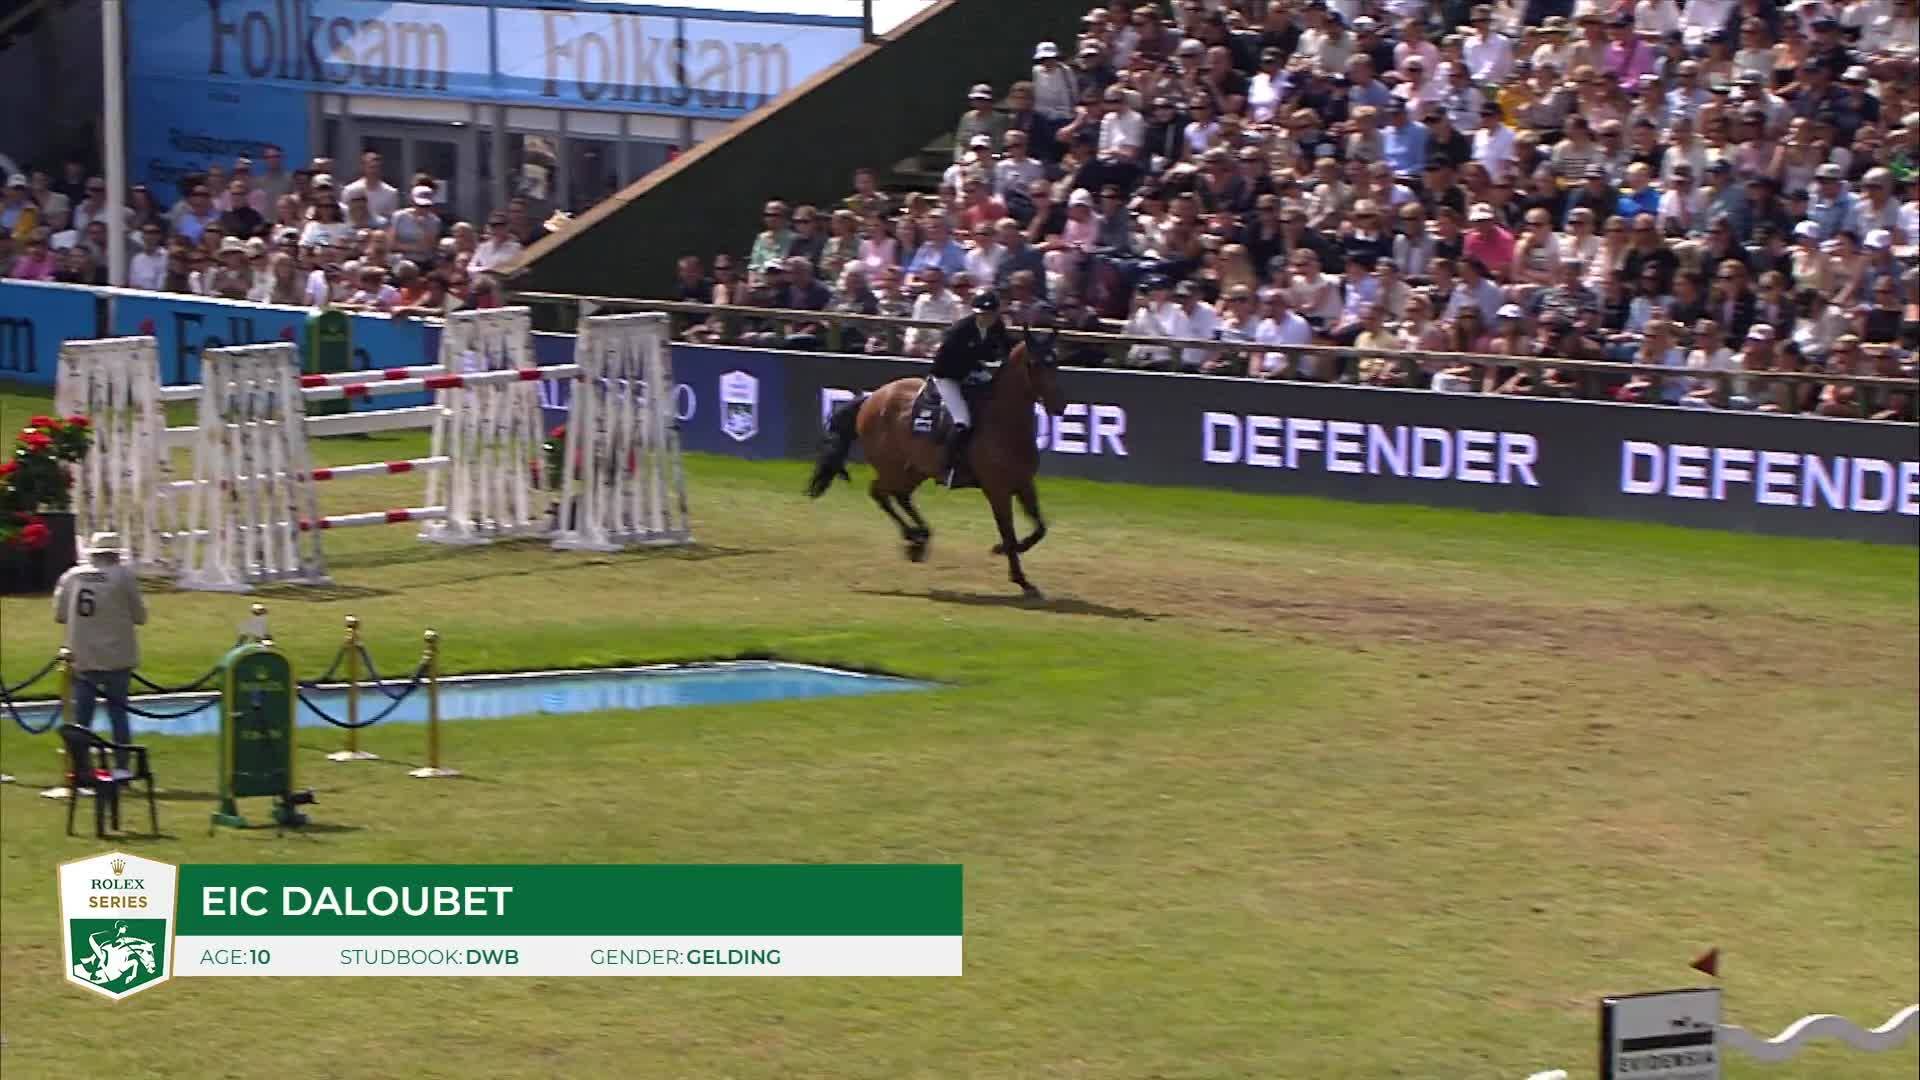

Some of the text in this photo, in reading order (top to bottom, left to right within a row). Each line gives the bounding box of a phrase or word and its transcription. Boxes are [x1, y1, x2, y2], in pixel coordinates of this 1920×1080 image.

[208, 0, 449, 91] Folksam
[539, 12, 790, 110] Folksam
[1203, 411, 1541, 486] DEFENDER
[78, 588, 95, 616] 6
